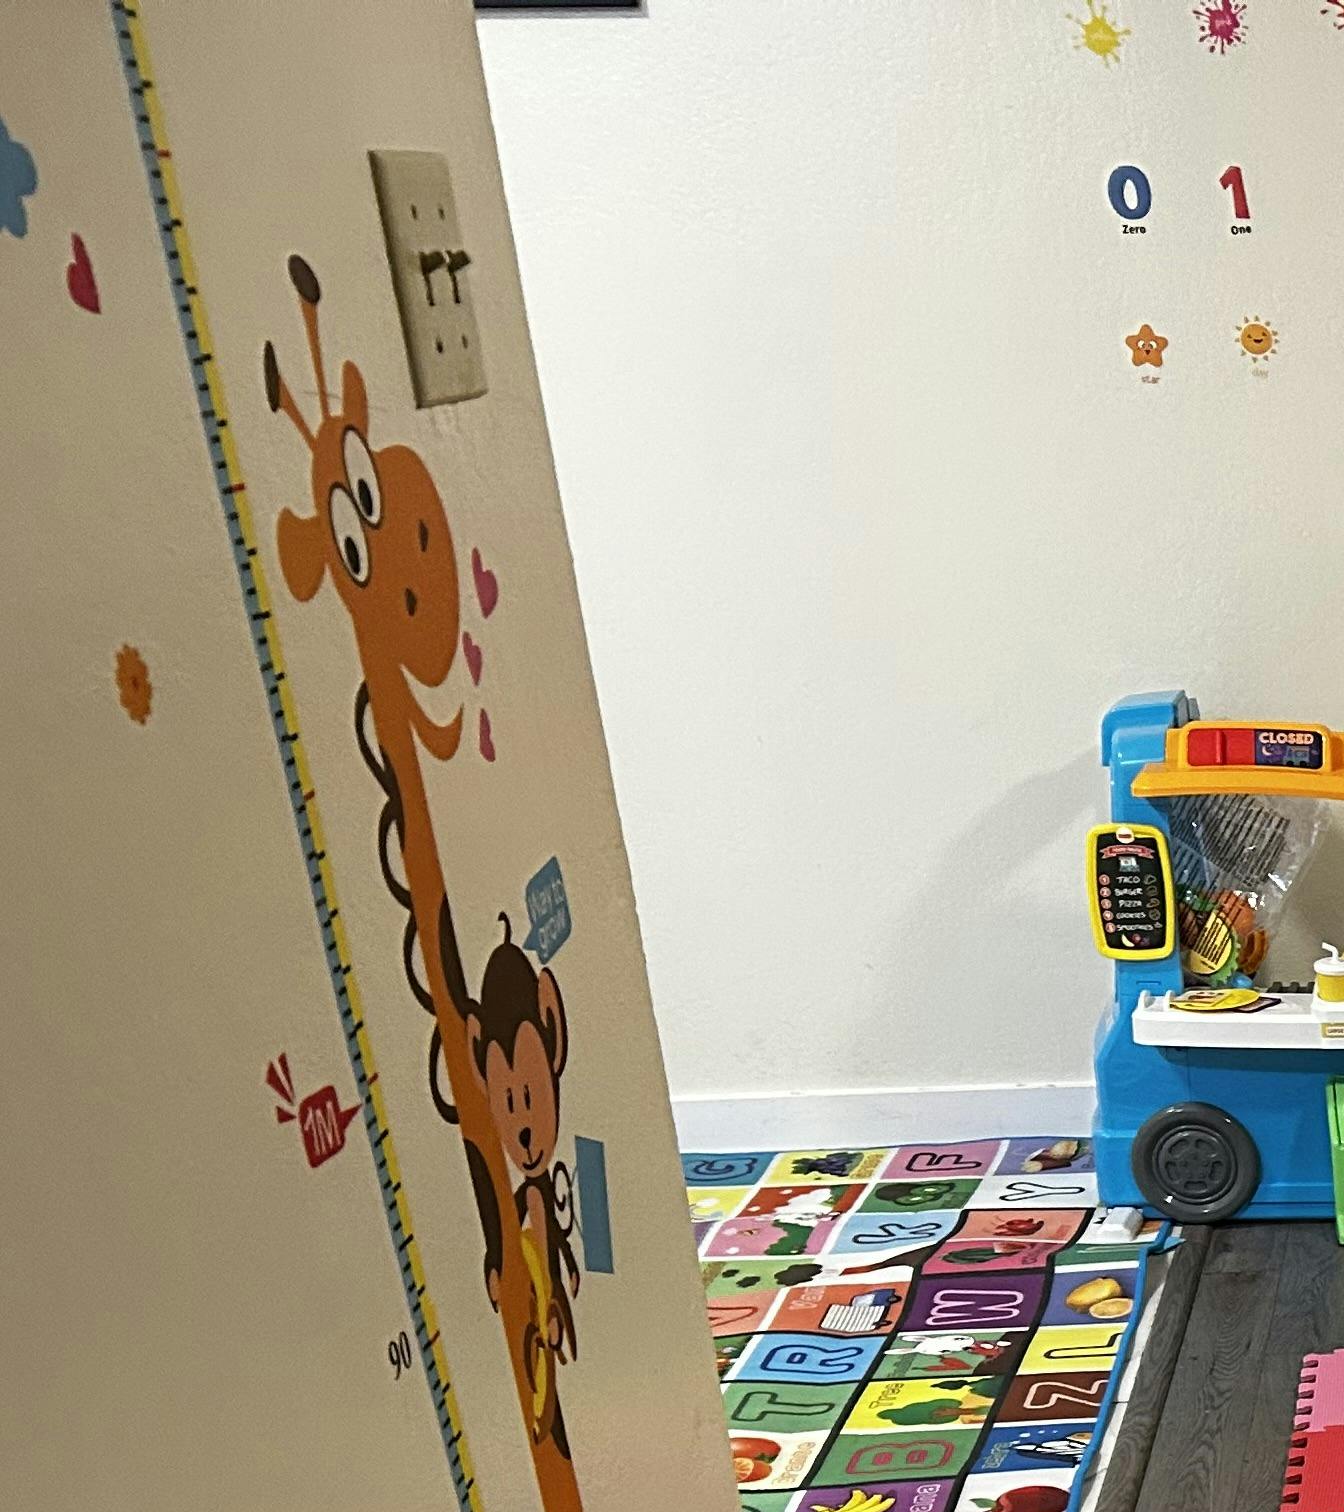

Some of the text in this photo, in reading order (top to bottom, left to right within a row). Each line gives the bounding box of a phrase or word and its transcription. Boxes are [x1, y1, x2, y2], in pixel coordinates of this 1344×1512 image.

[1108, 165, 1152, 220] 0
[1219, 166, 1250, 219] 1
[1122, 225, 1147, 234] Zero
[1231, 225, 1252, 235] One
[1258, 731, 1315, 745] CLOSED
[1114, 887, 1144, 897] BURGER
[1115, 876, 1141, 884] TACO
[529, 885, 554, 923] Way
[1118, 899, 1142, 908] PIZZA
[540, 905, 566, 958] grow
[304, 1100, 342, 1156] 1M
[905, 1152, 983, 1173] F
[999, 1182, 1086, 1202] Y
[852, 1222, 942, 1244] K
[926, 1289, 1024, 1326] W
[388, 1331, 413, 1381] 90
[760, 1344, 864, 1375] R
[1044, 1333, 1124, 1360] L
[731, 1391, 835, 1422] T
[869, 1382, 904, 1410] Tree
[1023, 1379, 1110, 1410] Z
[845, 1439, 956, 1475] B
